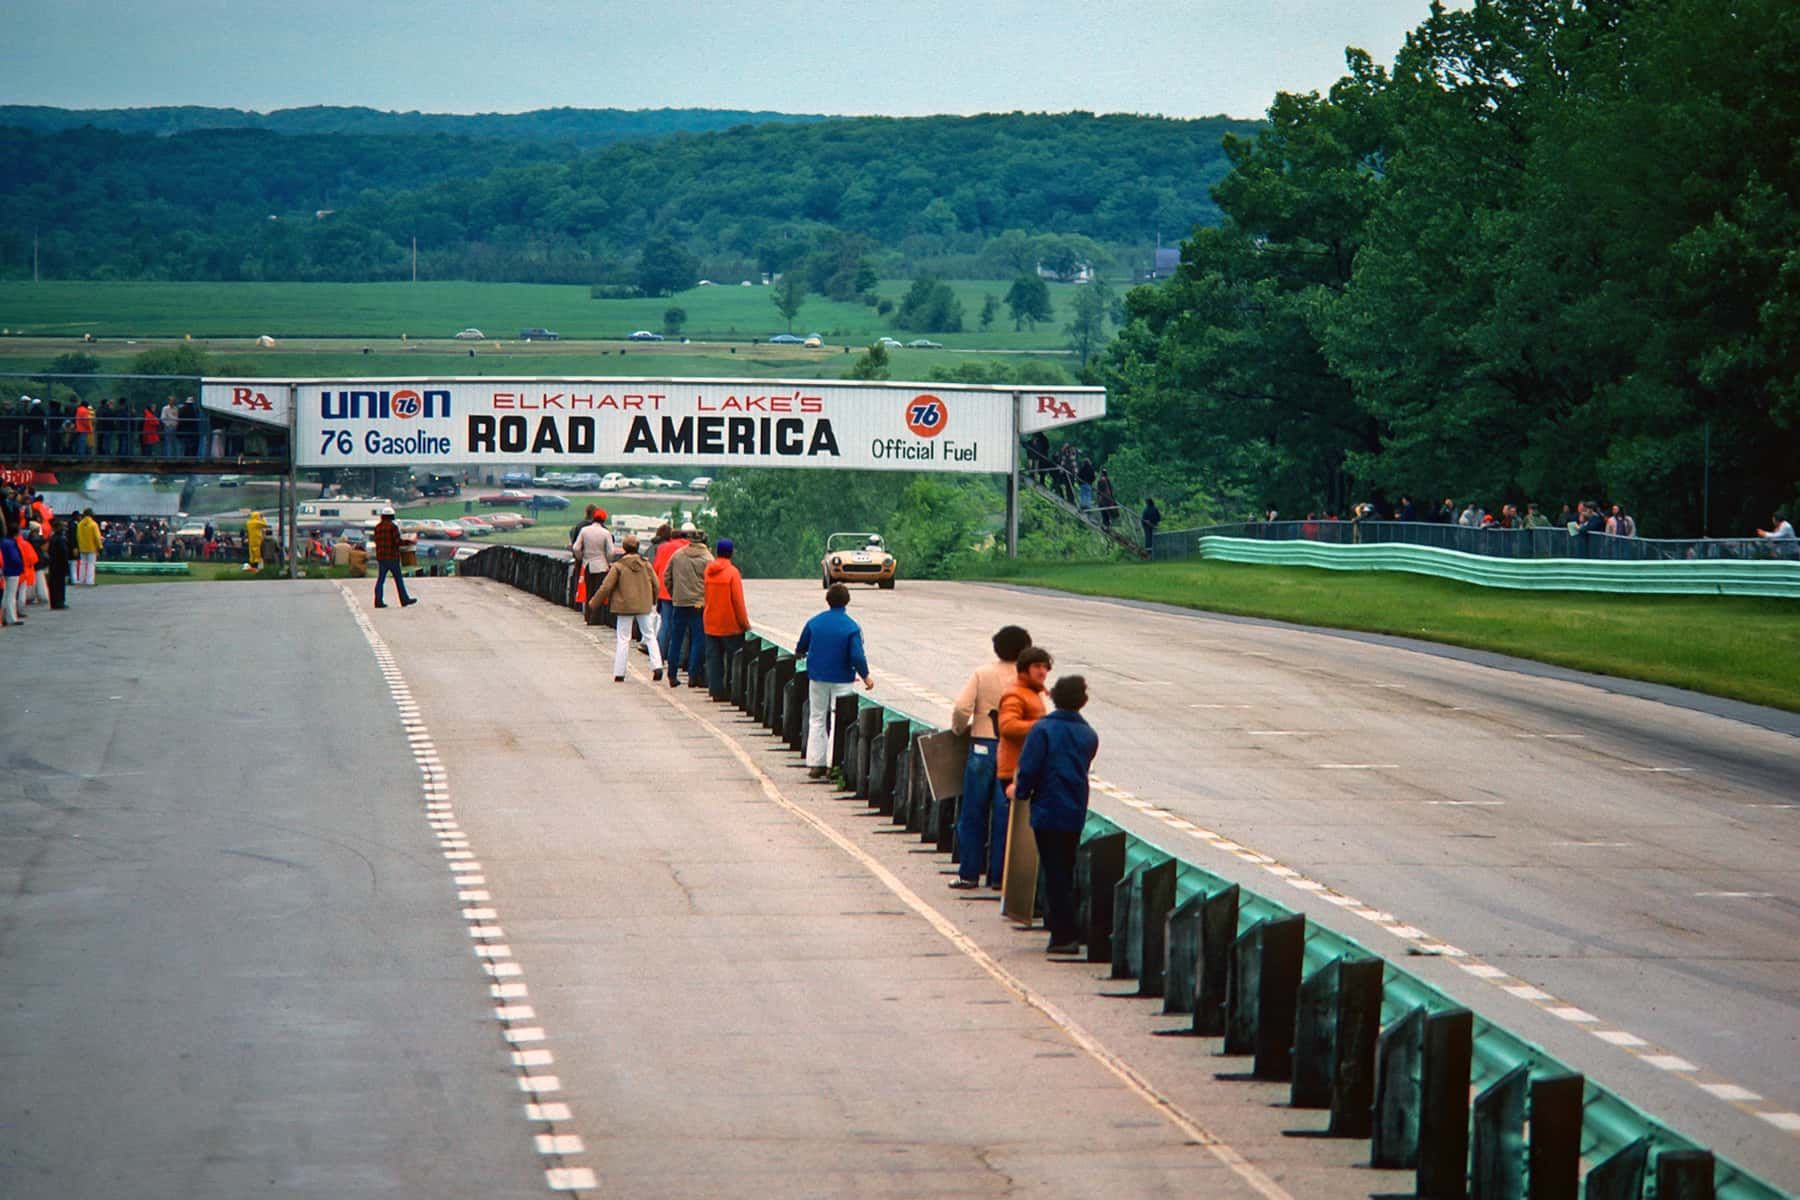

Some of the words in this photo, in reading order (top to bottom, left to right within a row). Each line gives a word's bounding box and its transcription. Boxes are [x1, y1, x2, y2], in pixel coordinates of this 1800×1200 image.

[232, 388, 272, 411] RA
[493, 393, 666, 411] ELKHART
[697, 391, 823, 414] LAKE'S
[1036, 396, 1077, 419] RA
[911, 402, 940, 426] 76
[320, 429, 354, 456] 76
[364, 428, 452, 456] Gasoline
[468, 415, 597, 454] ROAD
[622, 414, 842, 457] AMERICA
[871, 438, 935, 461] Official
[943, 440, 978, 462] Fuel
